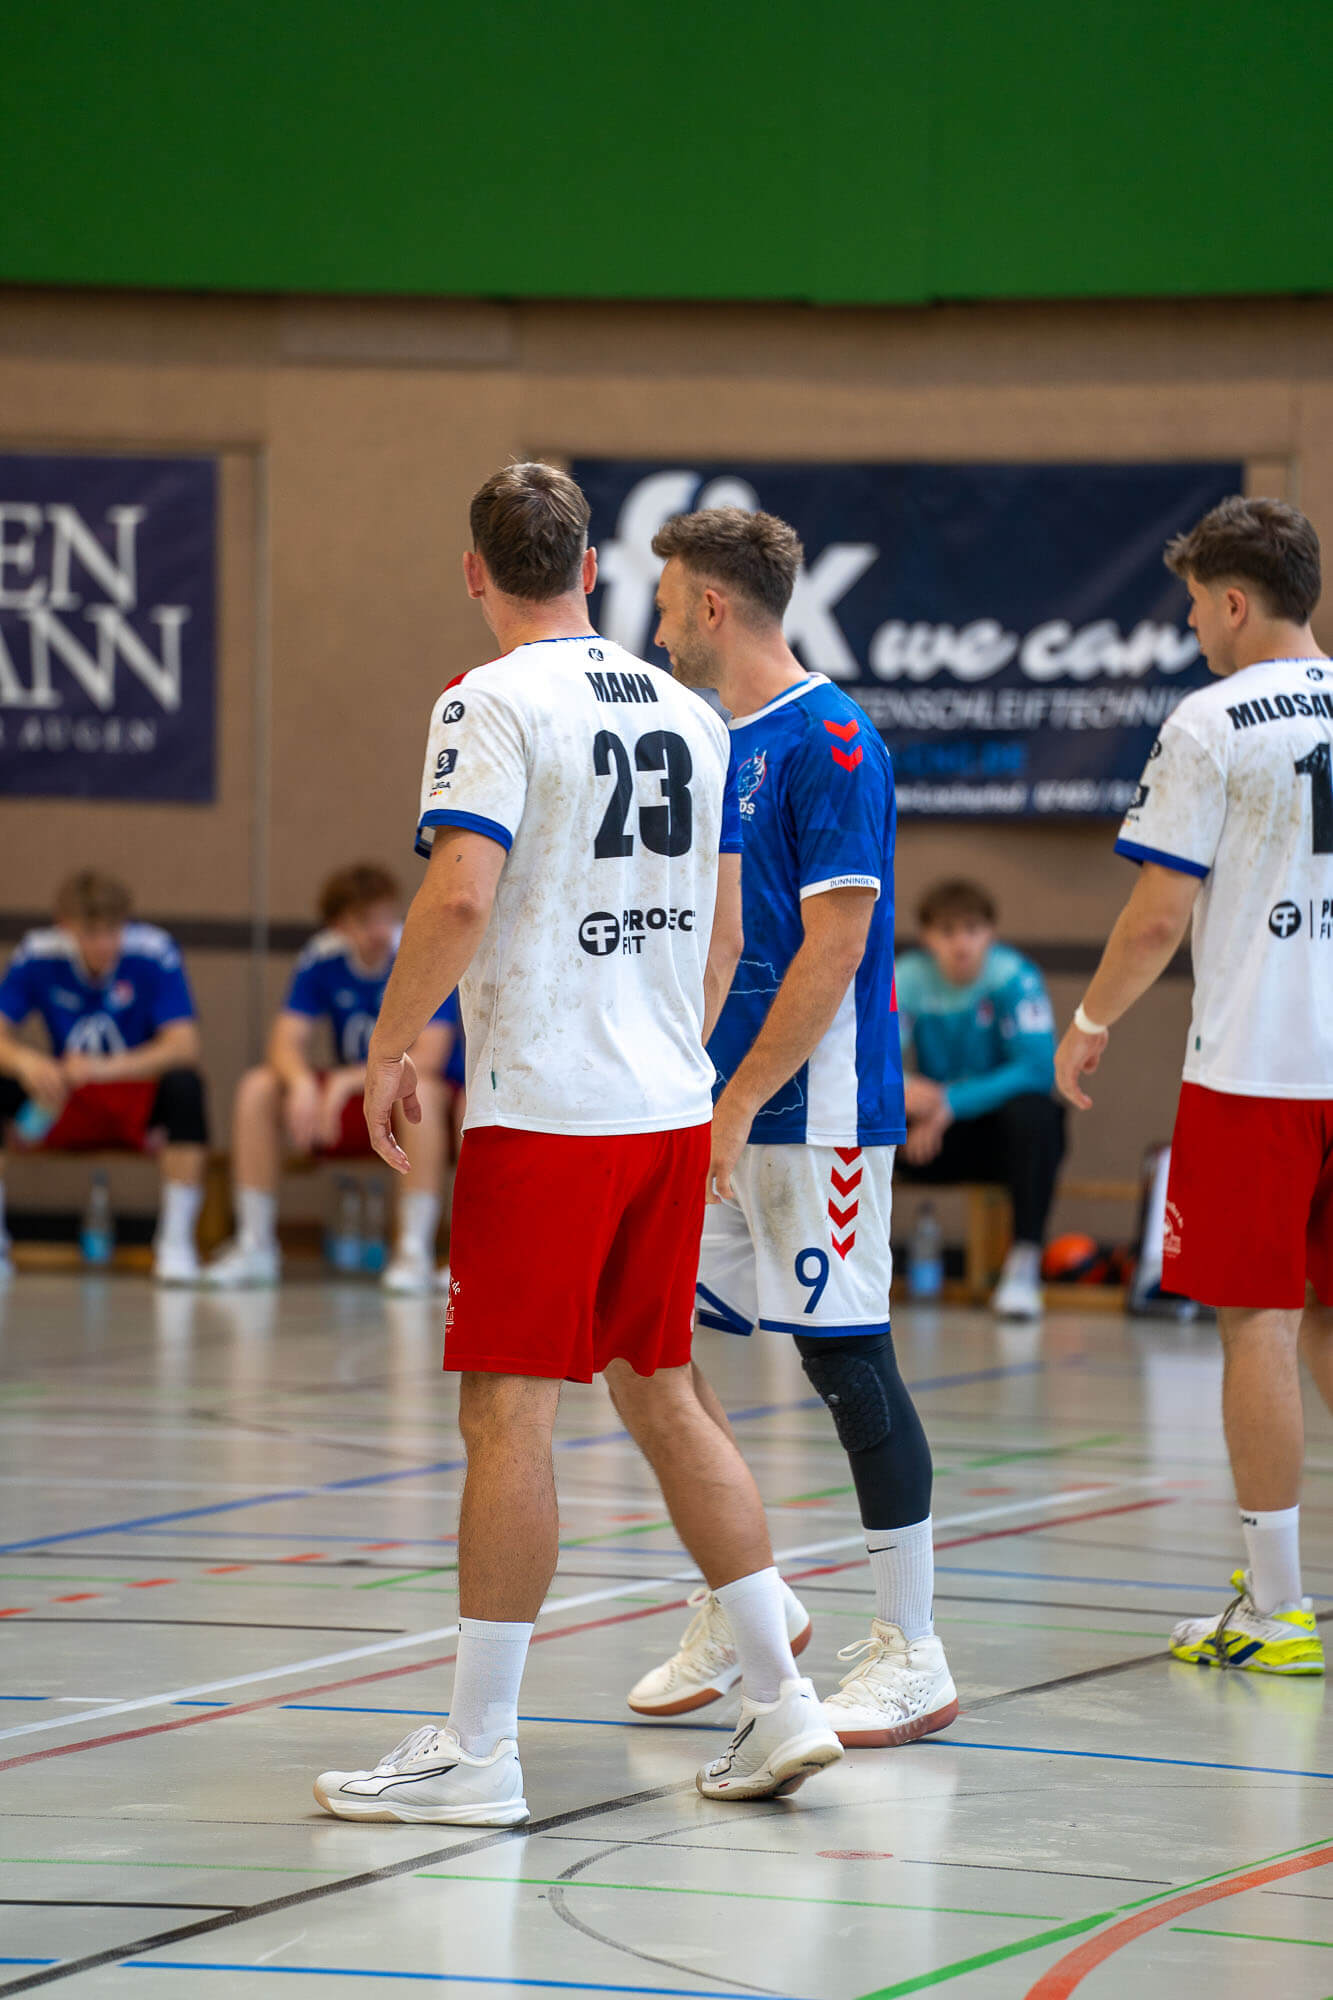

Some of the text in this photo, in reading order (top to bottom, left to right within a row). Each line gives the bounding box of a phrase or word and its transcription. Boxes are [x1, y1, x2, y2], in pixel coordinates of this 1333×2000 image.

[584, 671, 659, 703] MANN
[850, 686, 1190, 730] ENSCHLEIFTECHNI
[594, 729, 693, 860] 23
[622, 935, 646, 955] FIT
[794, 1247, 830, 1314] 9
